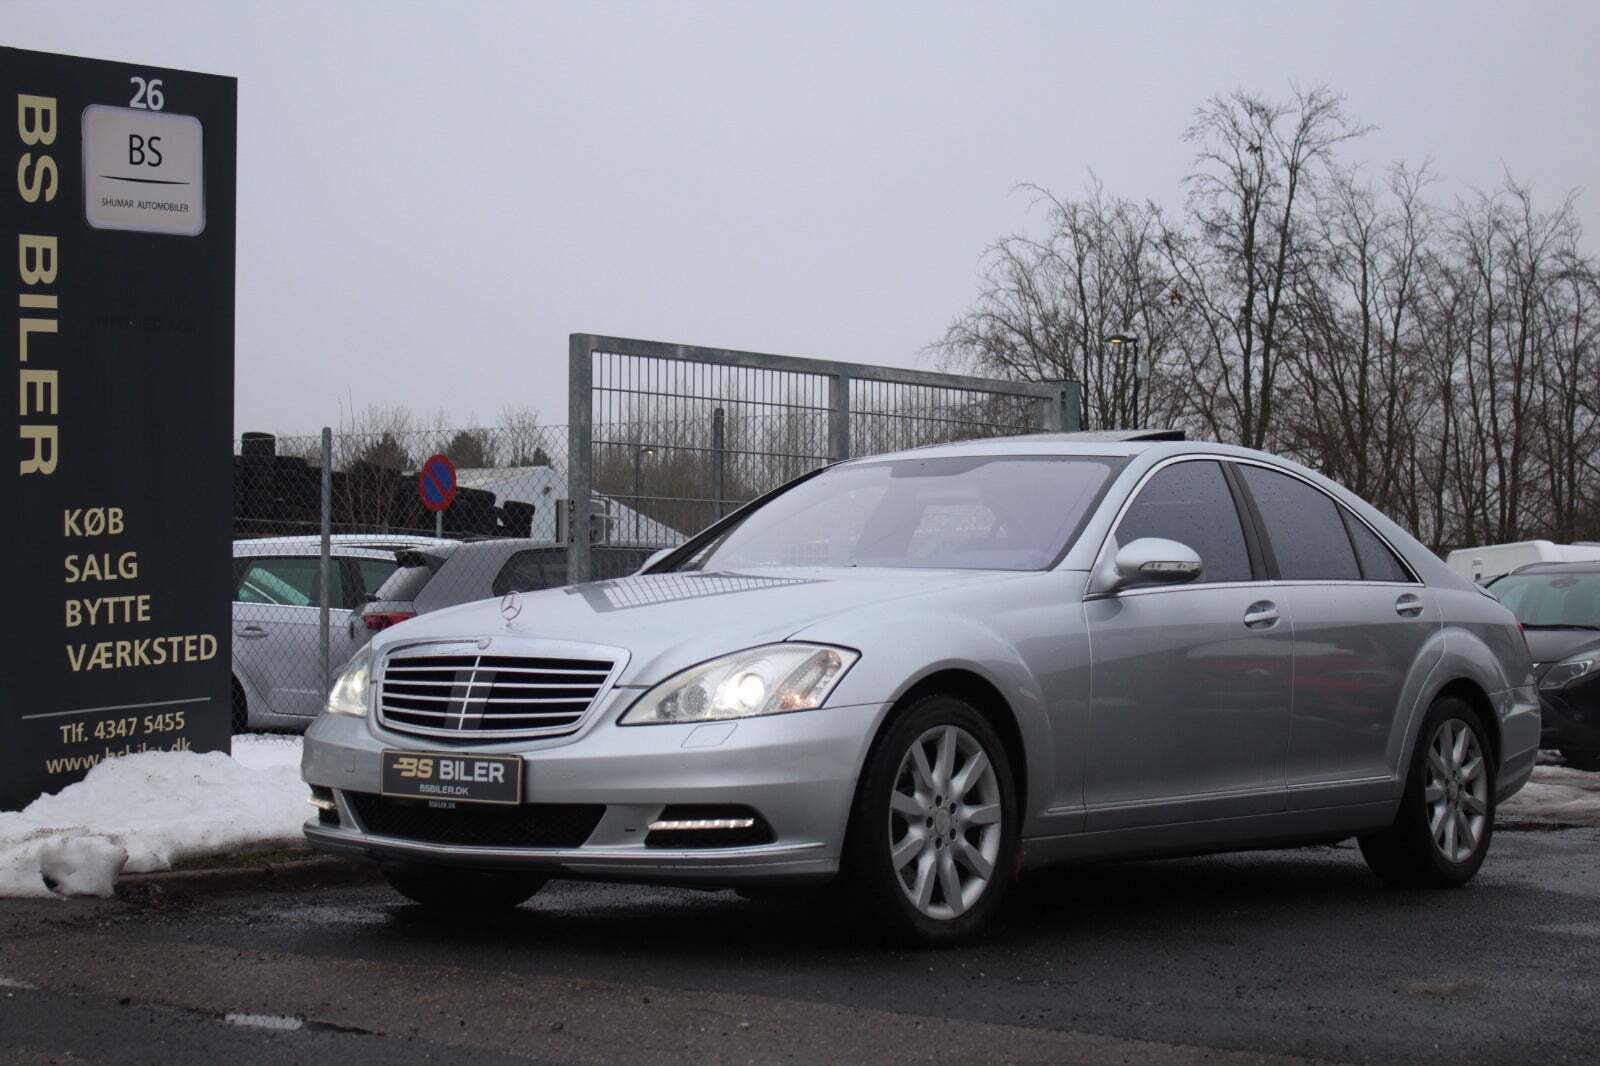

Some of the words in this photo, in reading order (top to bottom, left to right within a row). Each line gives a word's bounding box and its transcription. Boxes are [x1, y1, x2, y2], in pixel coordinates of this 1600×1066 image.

[129, 76, 164, 111] 26
[17, 93, 59, 204] BS
[128, 134, 163, 167] BS
[101, 197, 134, 209] SHUMAR
[137, 200, 189, 213] AUTOMOBILER
[18, 234, 59, 477] BILER
[64, 507, 125, 537] KØB
[64, 551, 139, 583] SALG
[65, 594, 151, 628] BYTTE
[66, 633, 218, 672] VÆRKSTED
[60, 722, 89, 744] Tlf.
[94, 717, 138, 740] 4347
[143, 711, 185, 734] 5455
[439, 759, 505, 783] BILER
[419, 783, 469, 796] BSBILER.DK
